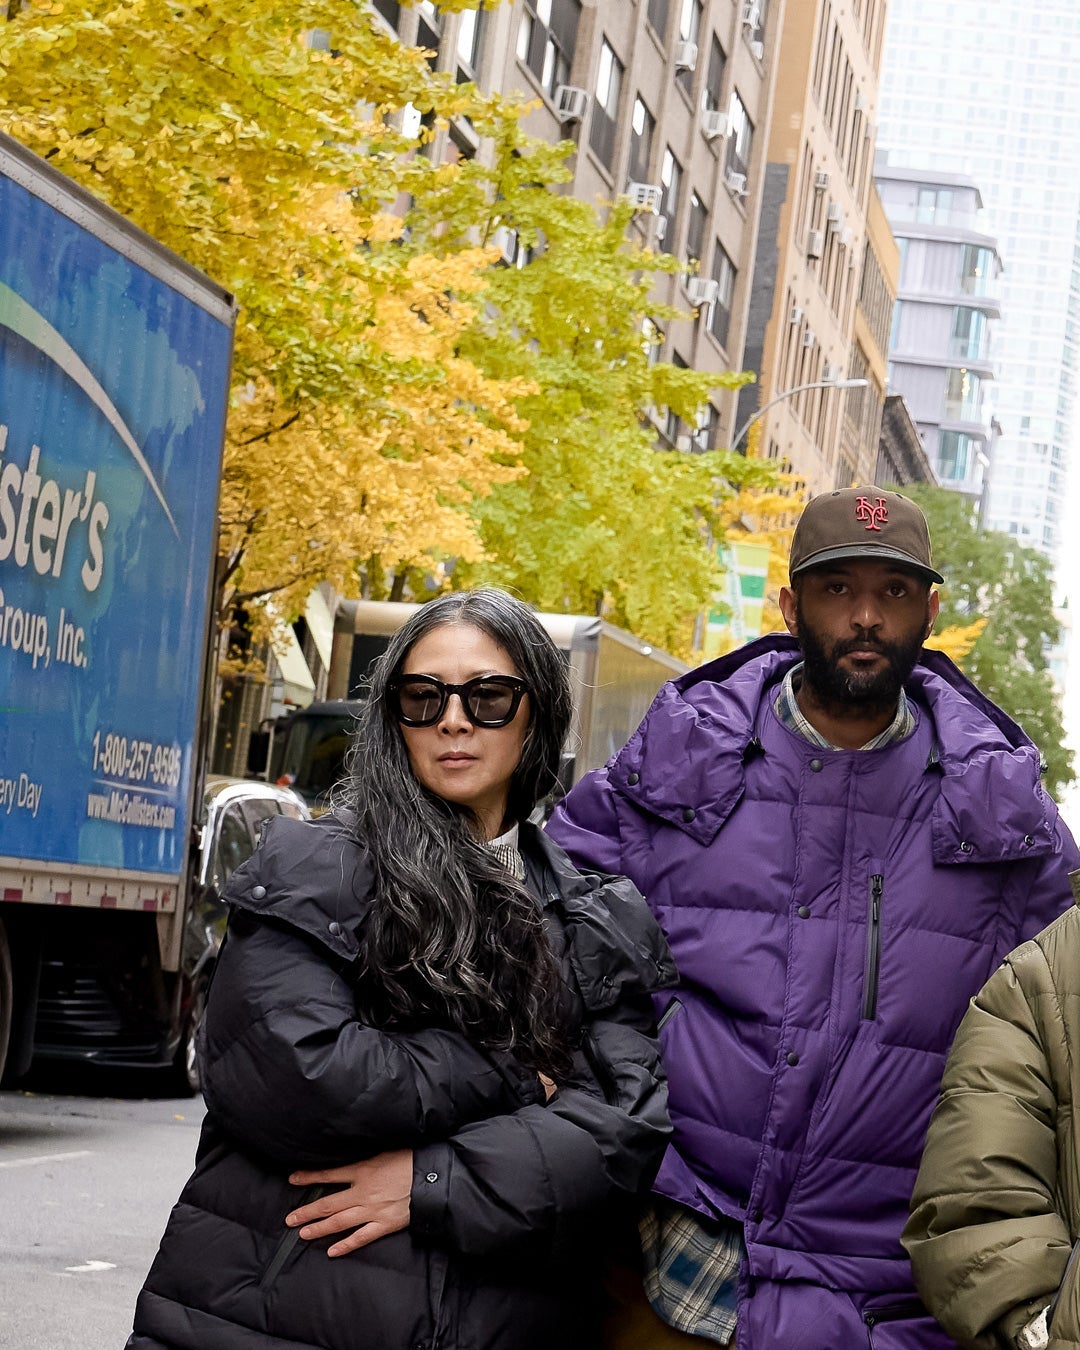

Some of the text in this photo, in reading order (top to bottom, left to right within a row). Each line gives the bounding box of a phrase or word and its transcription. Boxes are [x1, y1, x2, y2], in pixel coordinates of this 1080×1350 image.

[856, 496, 888, 530] NY
[56, 607, 87, 669] Inc.
[93, 730, 181, 787] 1-800-257-9595
[18, 773, 42, 818] Day
